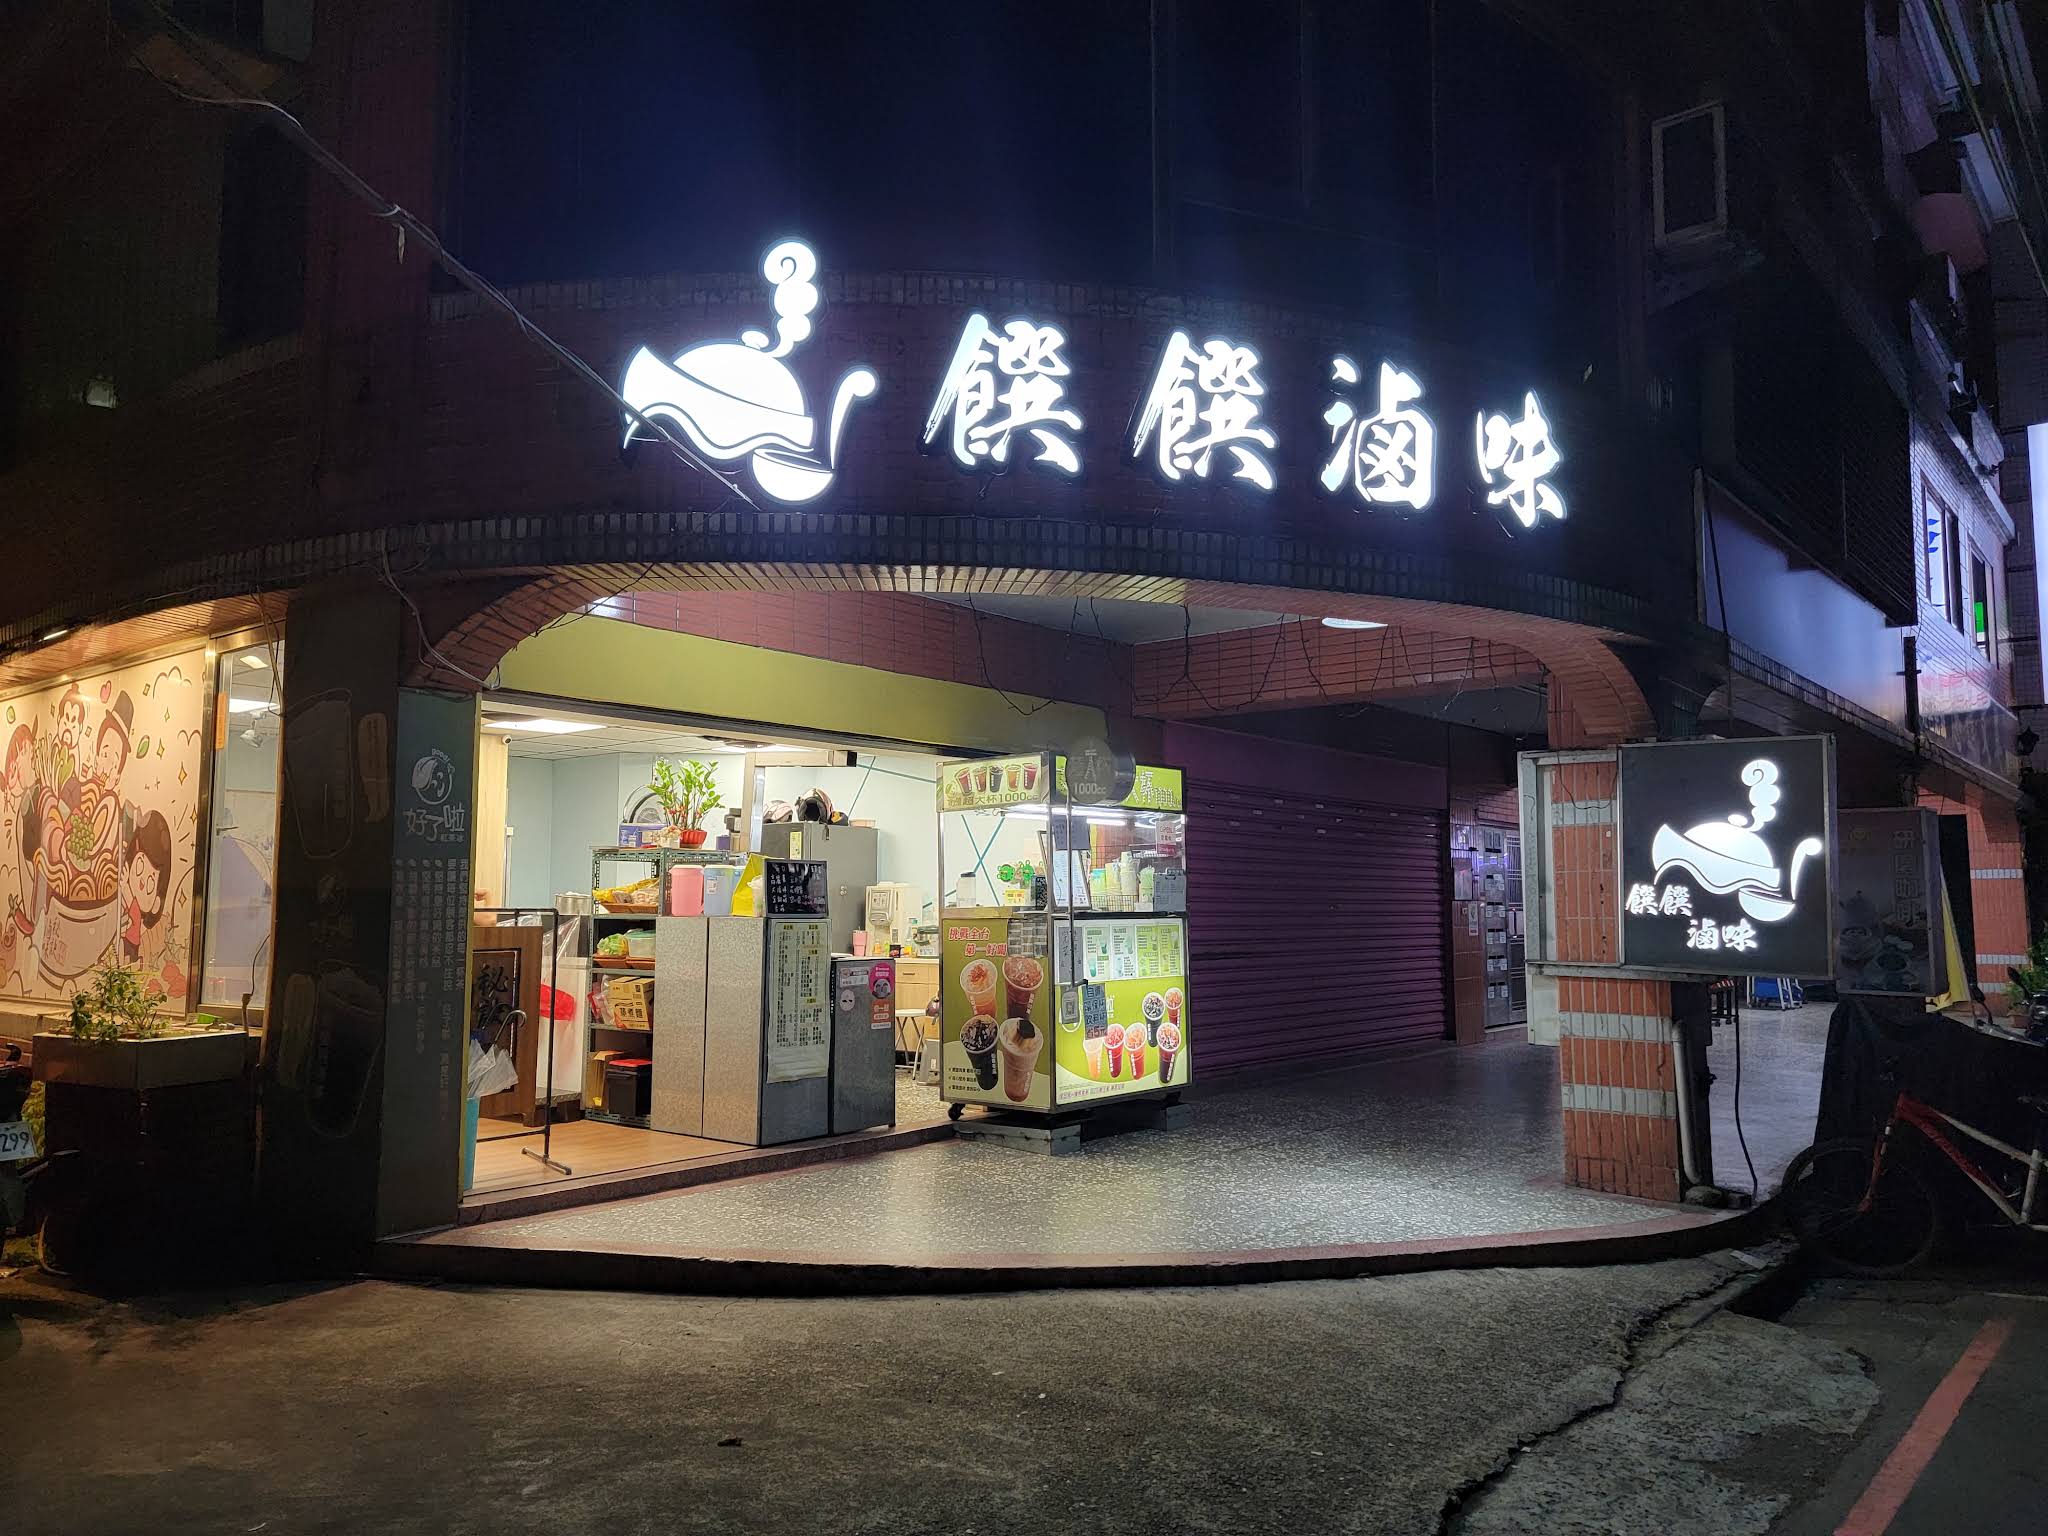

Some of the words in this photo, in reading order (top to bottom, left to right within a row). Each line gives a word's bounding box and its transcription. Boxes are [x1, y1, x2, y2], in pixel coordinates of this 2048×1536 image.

[402, 803, 465, 842] 好了啦
[1687, 917, 1757, 952] 滷味
